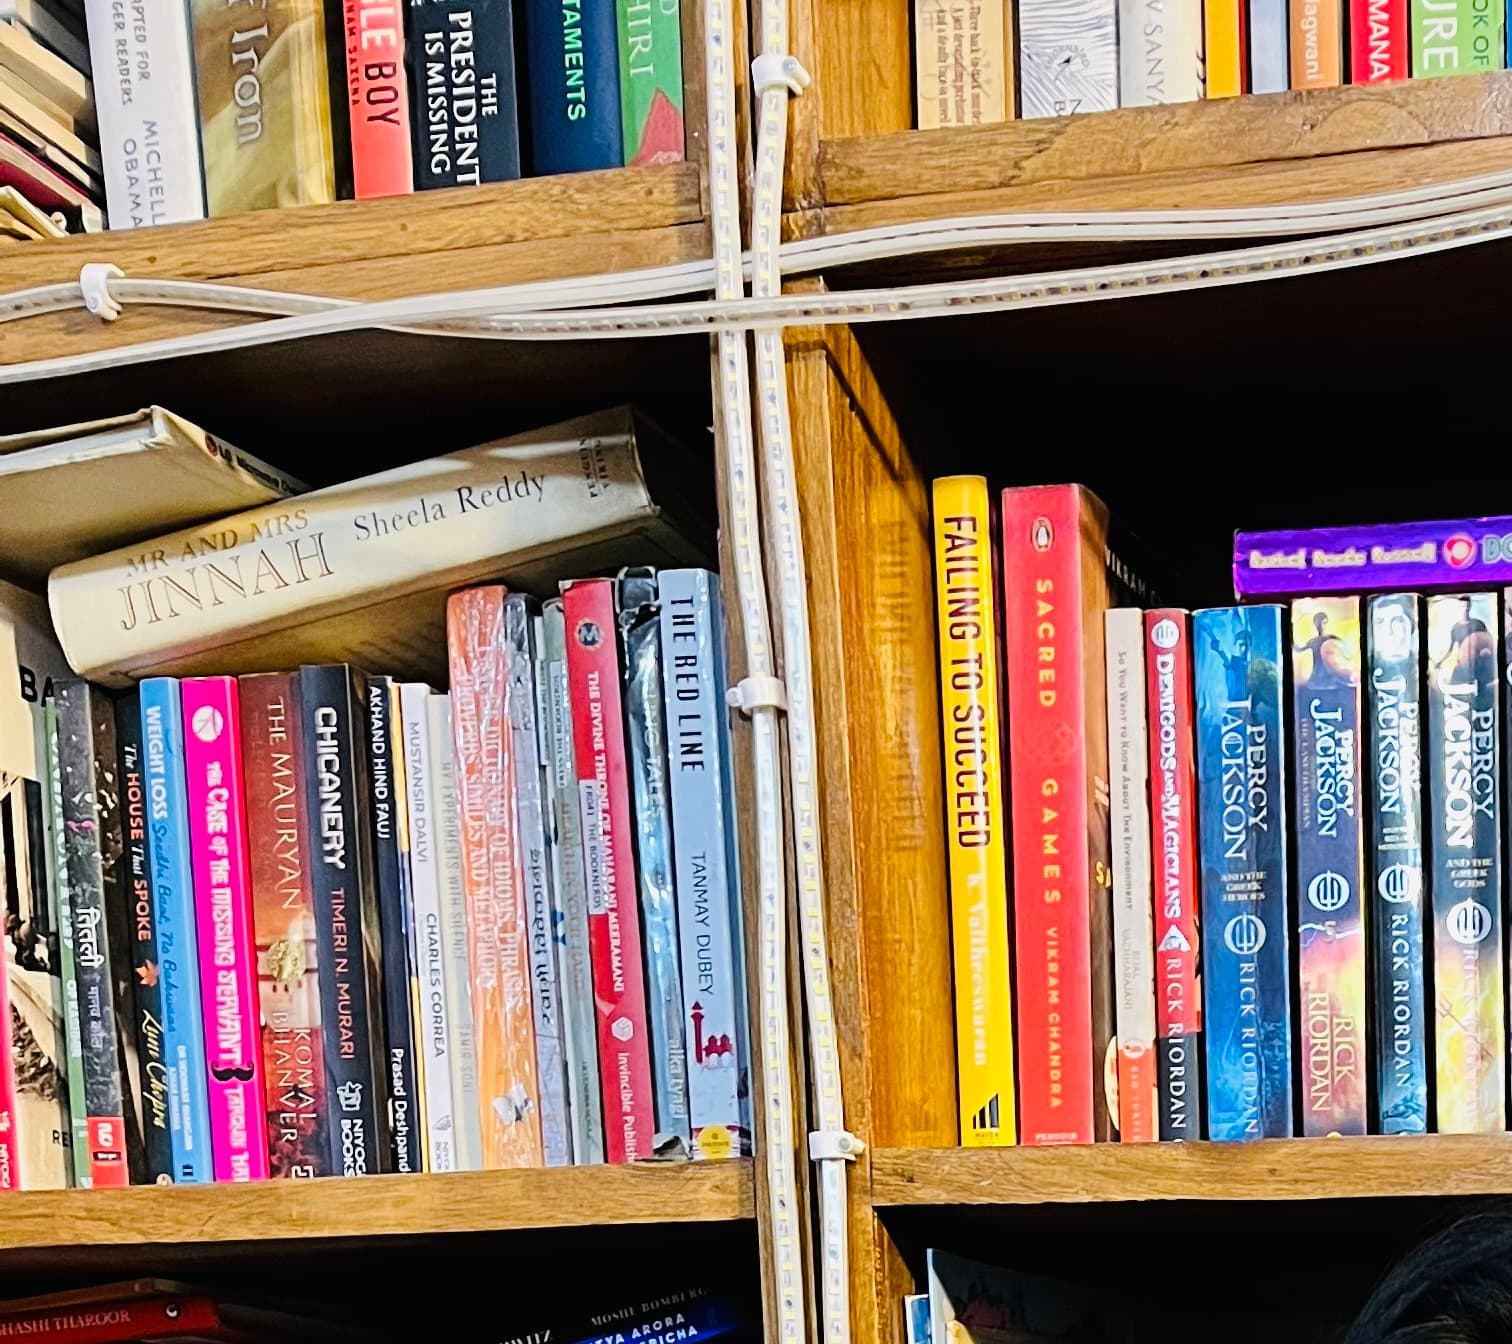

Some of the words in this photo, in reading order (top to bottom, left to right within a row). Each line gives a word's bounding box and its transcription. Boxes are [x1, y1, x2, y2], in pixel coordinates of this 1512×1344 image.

[425, 31, 444, 55] IS
[365, 62, 400, 127] BOY
[427, 62, 450, 174] MISSING
[449, 11, 480, 186] PRESIDENT
[481, 73, 497, 117] THE
[352, 497, 447, 543] Sheela
[454, 471, 547, 513] Reddy
[125, 555, 173, 580] MR
[180, 527, 239, 567] AND
[248, 508, 310, 545] MRS
[943, 515, 978, 640] FAILING
[117, 532, 335, 633] JINNAH
[672, 597, 694, 642] THE
[1036, 578, 1055, 708] SACRED
[675, 653, 698, 700] RED
[951, 650, 984, 691] TO
[146, 705, 164, 769] WEIGHT
[266, 700, 287, 745] THE
[369, 685, 383, 736] AKHAND
[681, 707, 705, 773] LINE
[152, 774, 170, 820] LOSS
[315, 706, 347, 871] CHICANERY
[373, 743, 386, 783] HIND
[953, 703, 991, 849] SUCCEED
[272, 753, 301, 910] MAURYAN
[375, 792, 389, 840] FAUJ
[1041, 779, 1061, 904] GAMES
[331, 888, 347, 947] TIMERI
[691, 851, 711, 927] TANMAY
[695, 932, 714, 995] DUBEY
[1046, 926, 1062, 1008] VIKRAM
[1166, 955, 1185, 1010] RICK
[336, 978, 352, 1059] MURARI
[292, 1028, 317, 1127] KOMAL
[1047, 1016, 1063, 1110] CHANDRA
[1168, 1019, 1187, 1130] RIORDAN
[631, 1312, 687, 1344] ARORA
